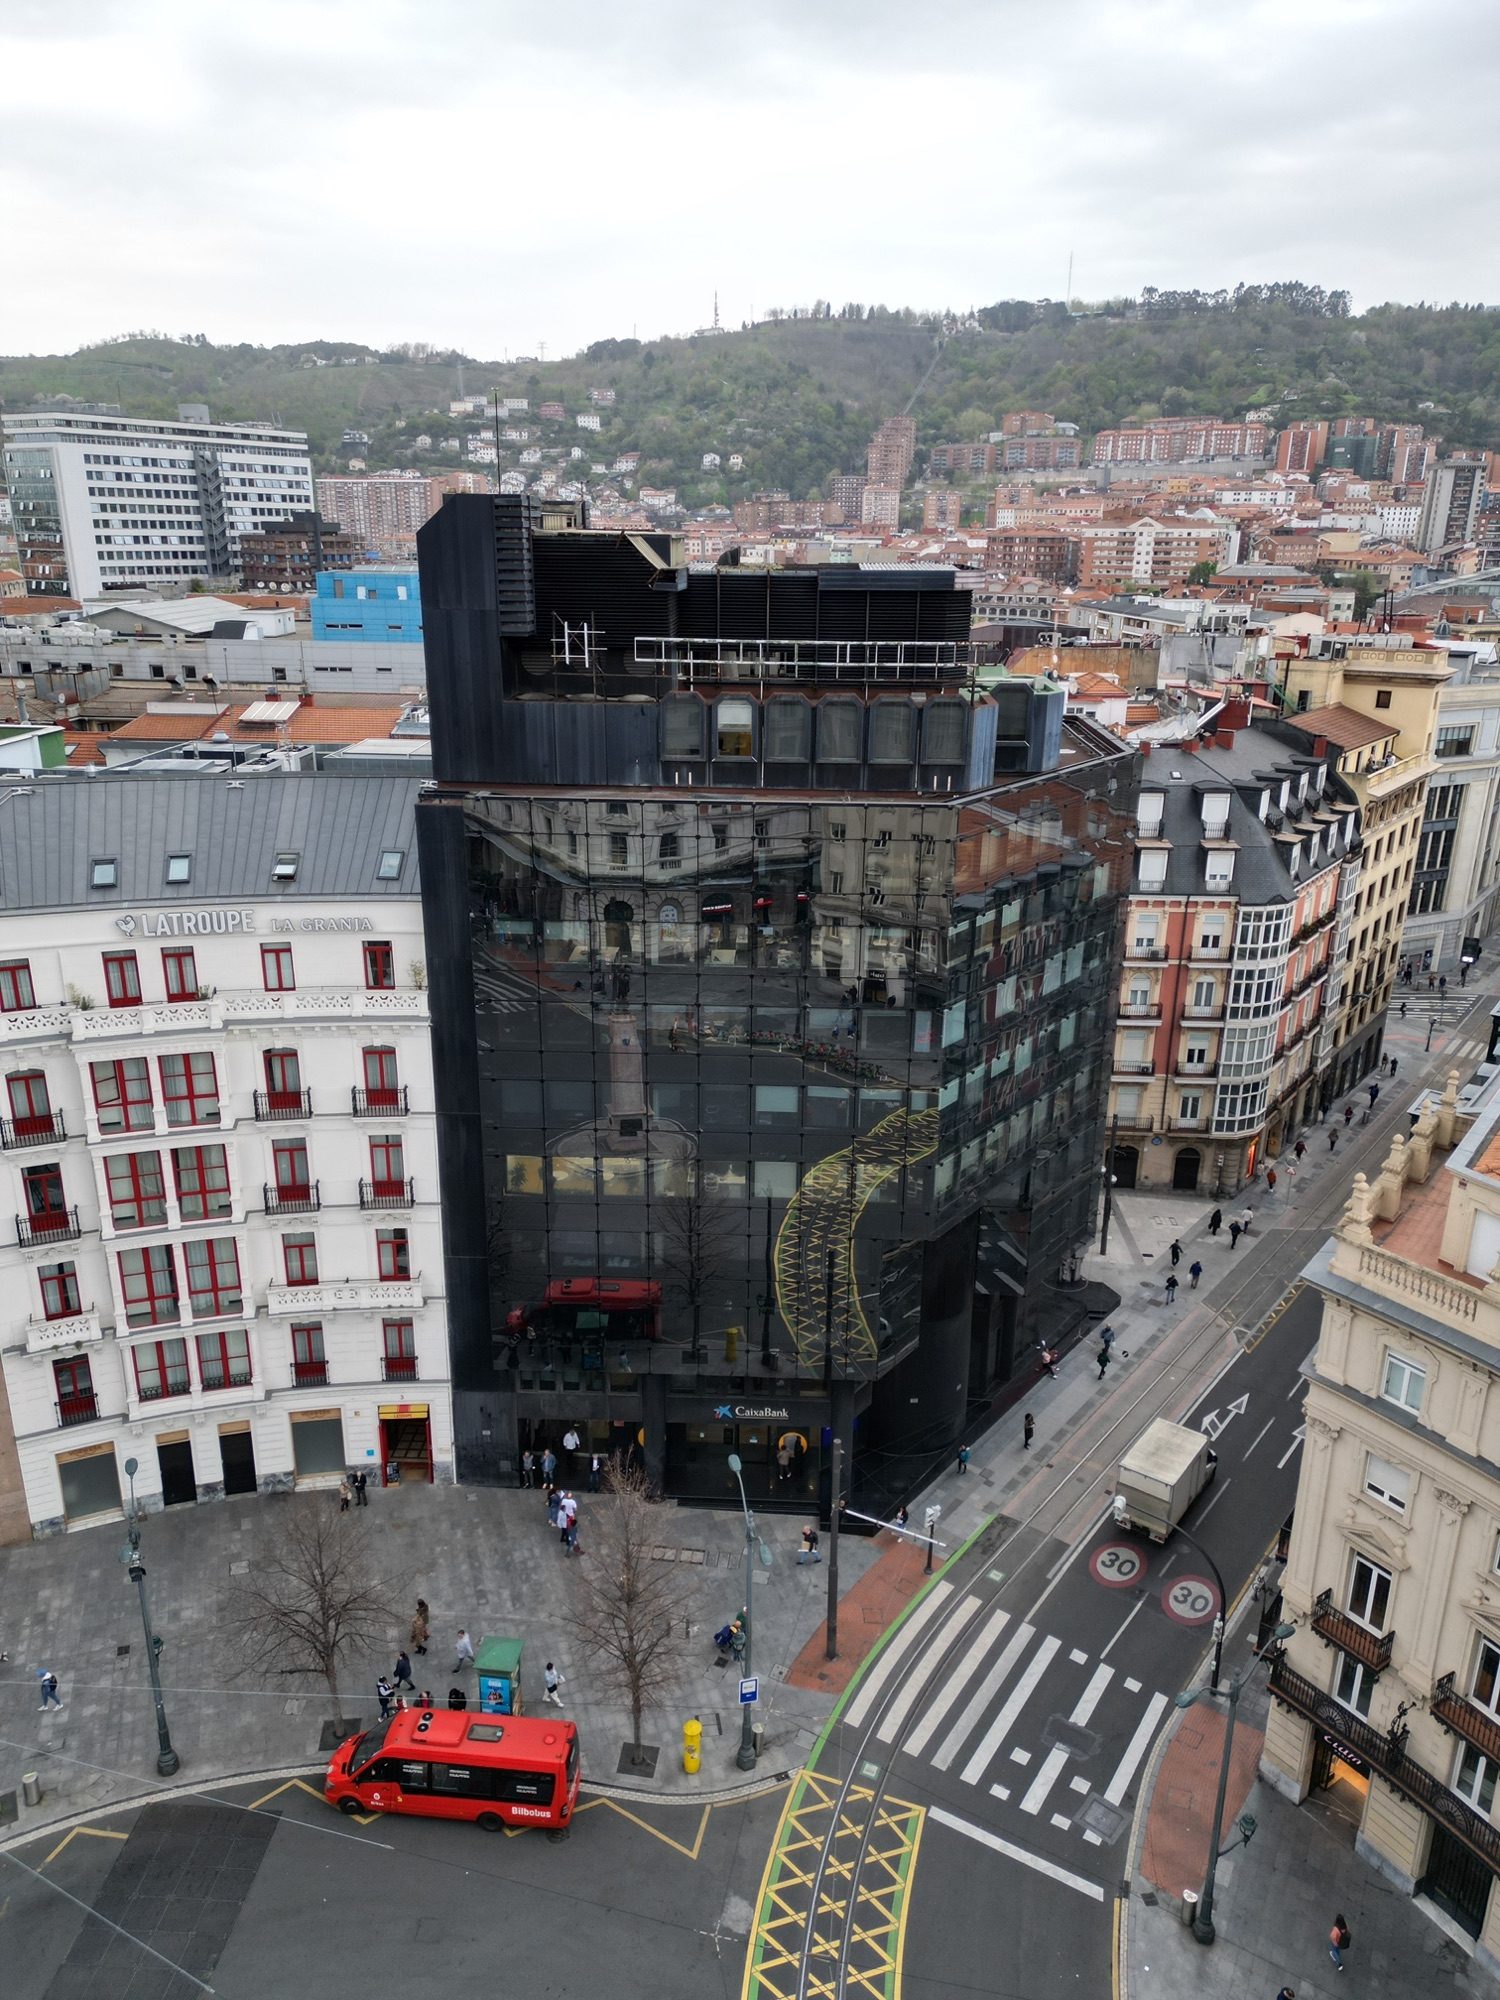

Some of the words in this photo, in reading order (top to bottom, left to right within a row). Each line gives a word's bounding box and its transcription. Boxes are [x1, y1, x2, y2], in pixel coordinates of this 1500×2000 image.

[141, 910, 255, 937] LATROUPE
[271, 919, 295, 932] LA
[300, 917, 373, 932] GRANJA
[735, 1405, 789, 1418] CaixaBank
[1100, 1551, 1136, 1577] 30
[1173, 1586, 1209, 1613] 30
[511, 1806, 552, 1818] Bilbobus
